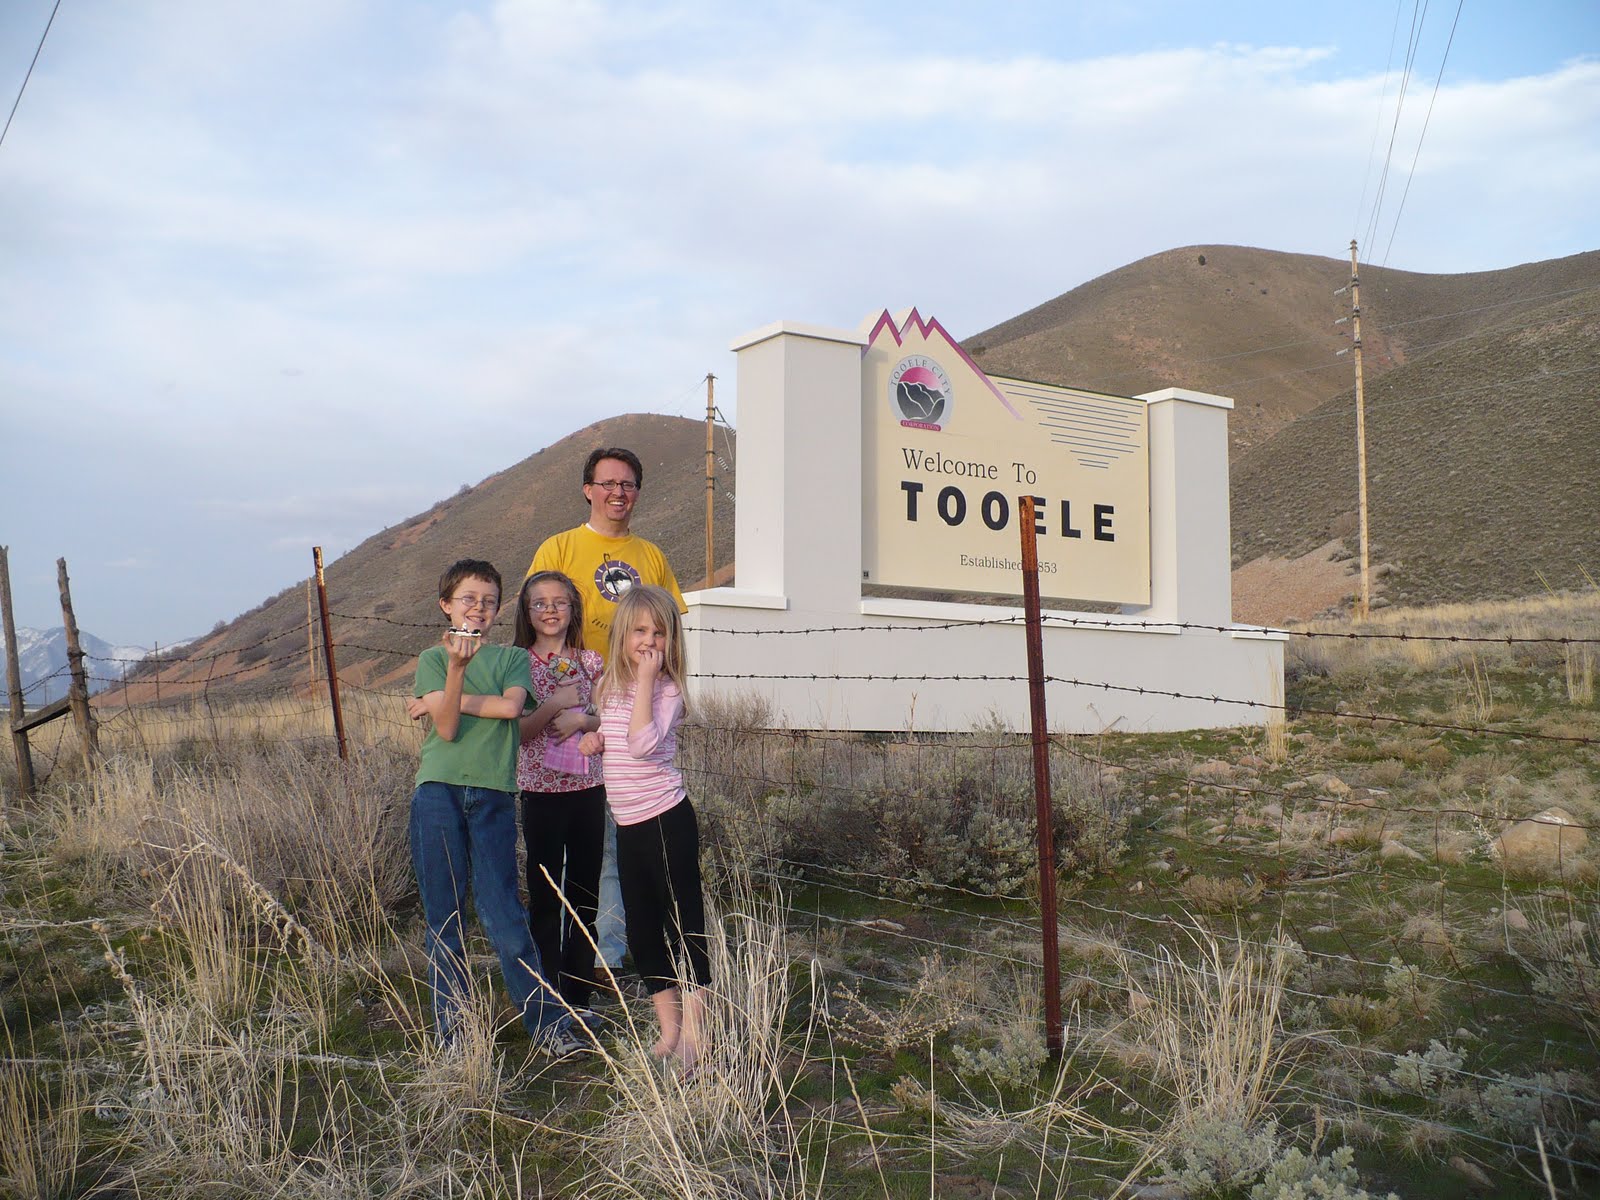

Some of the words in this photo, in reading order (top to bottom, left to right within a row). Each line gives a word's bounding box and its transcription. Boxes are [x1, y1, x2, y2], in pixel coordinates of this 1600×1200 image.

[890, 358, 928, 386] TOOELE
[931, 366, 951, 395] CITY
[901, 447, 998, 480] Welcome
[1012, 462, 1037, 485] To
[900, 480, 1115, 543] TOOELE
[1037, 561, 1057, 574] 853
